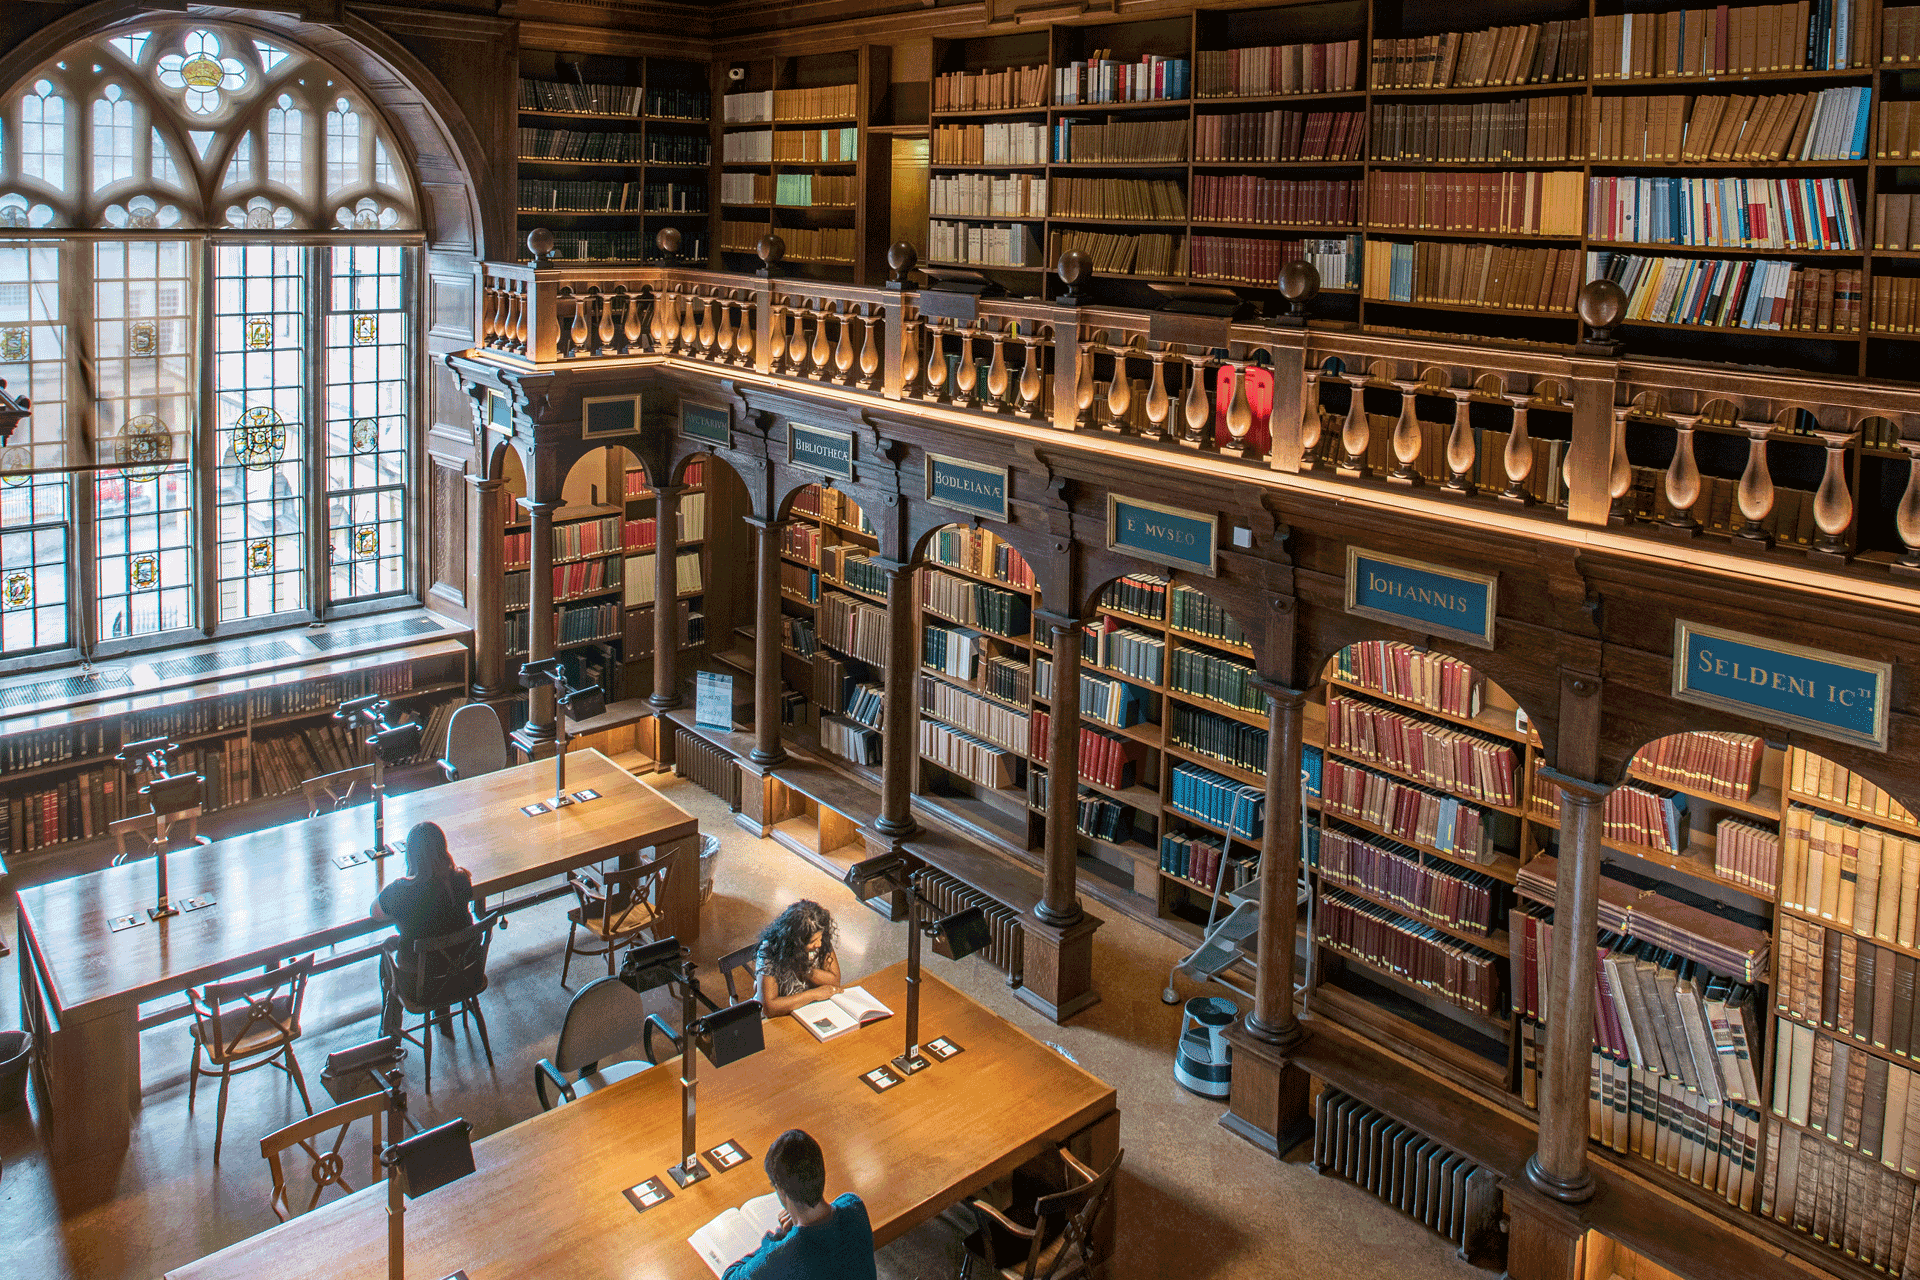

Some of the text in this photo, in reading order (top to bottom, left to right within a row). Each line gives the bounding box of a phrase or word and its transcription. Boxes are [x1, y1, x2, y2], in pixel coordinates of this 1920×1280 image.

[936, 471, 1002, 498] BODLEIANÆ
[1127, 518, 1195, 545] E MVSEO
[1369, 572, 1467, 613] IOHANNIS
[1699, 649, 1816, 698] SELDENI
